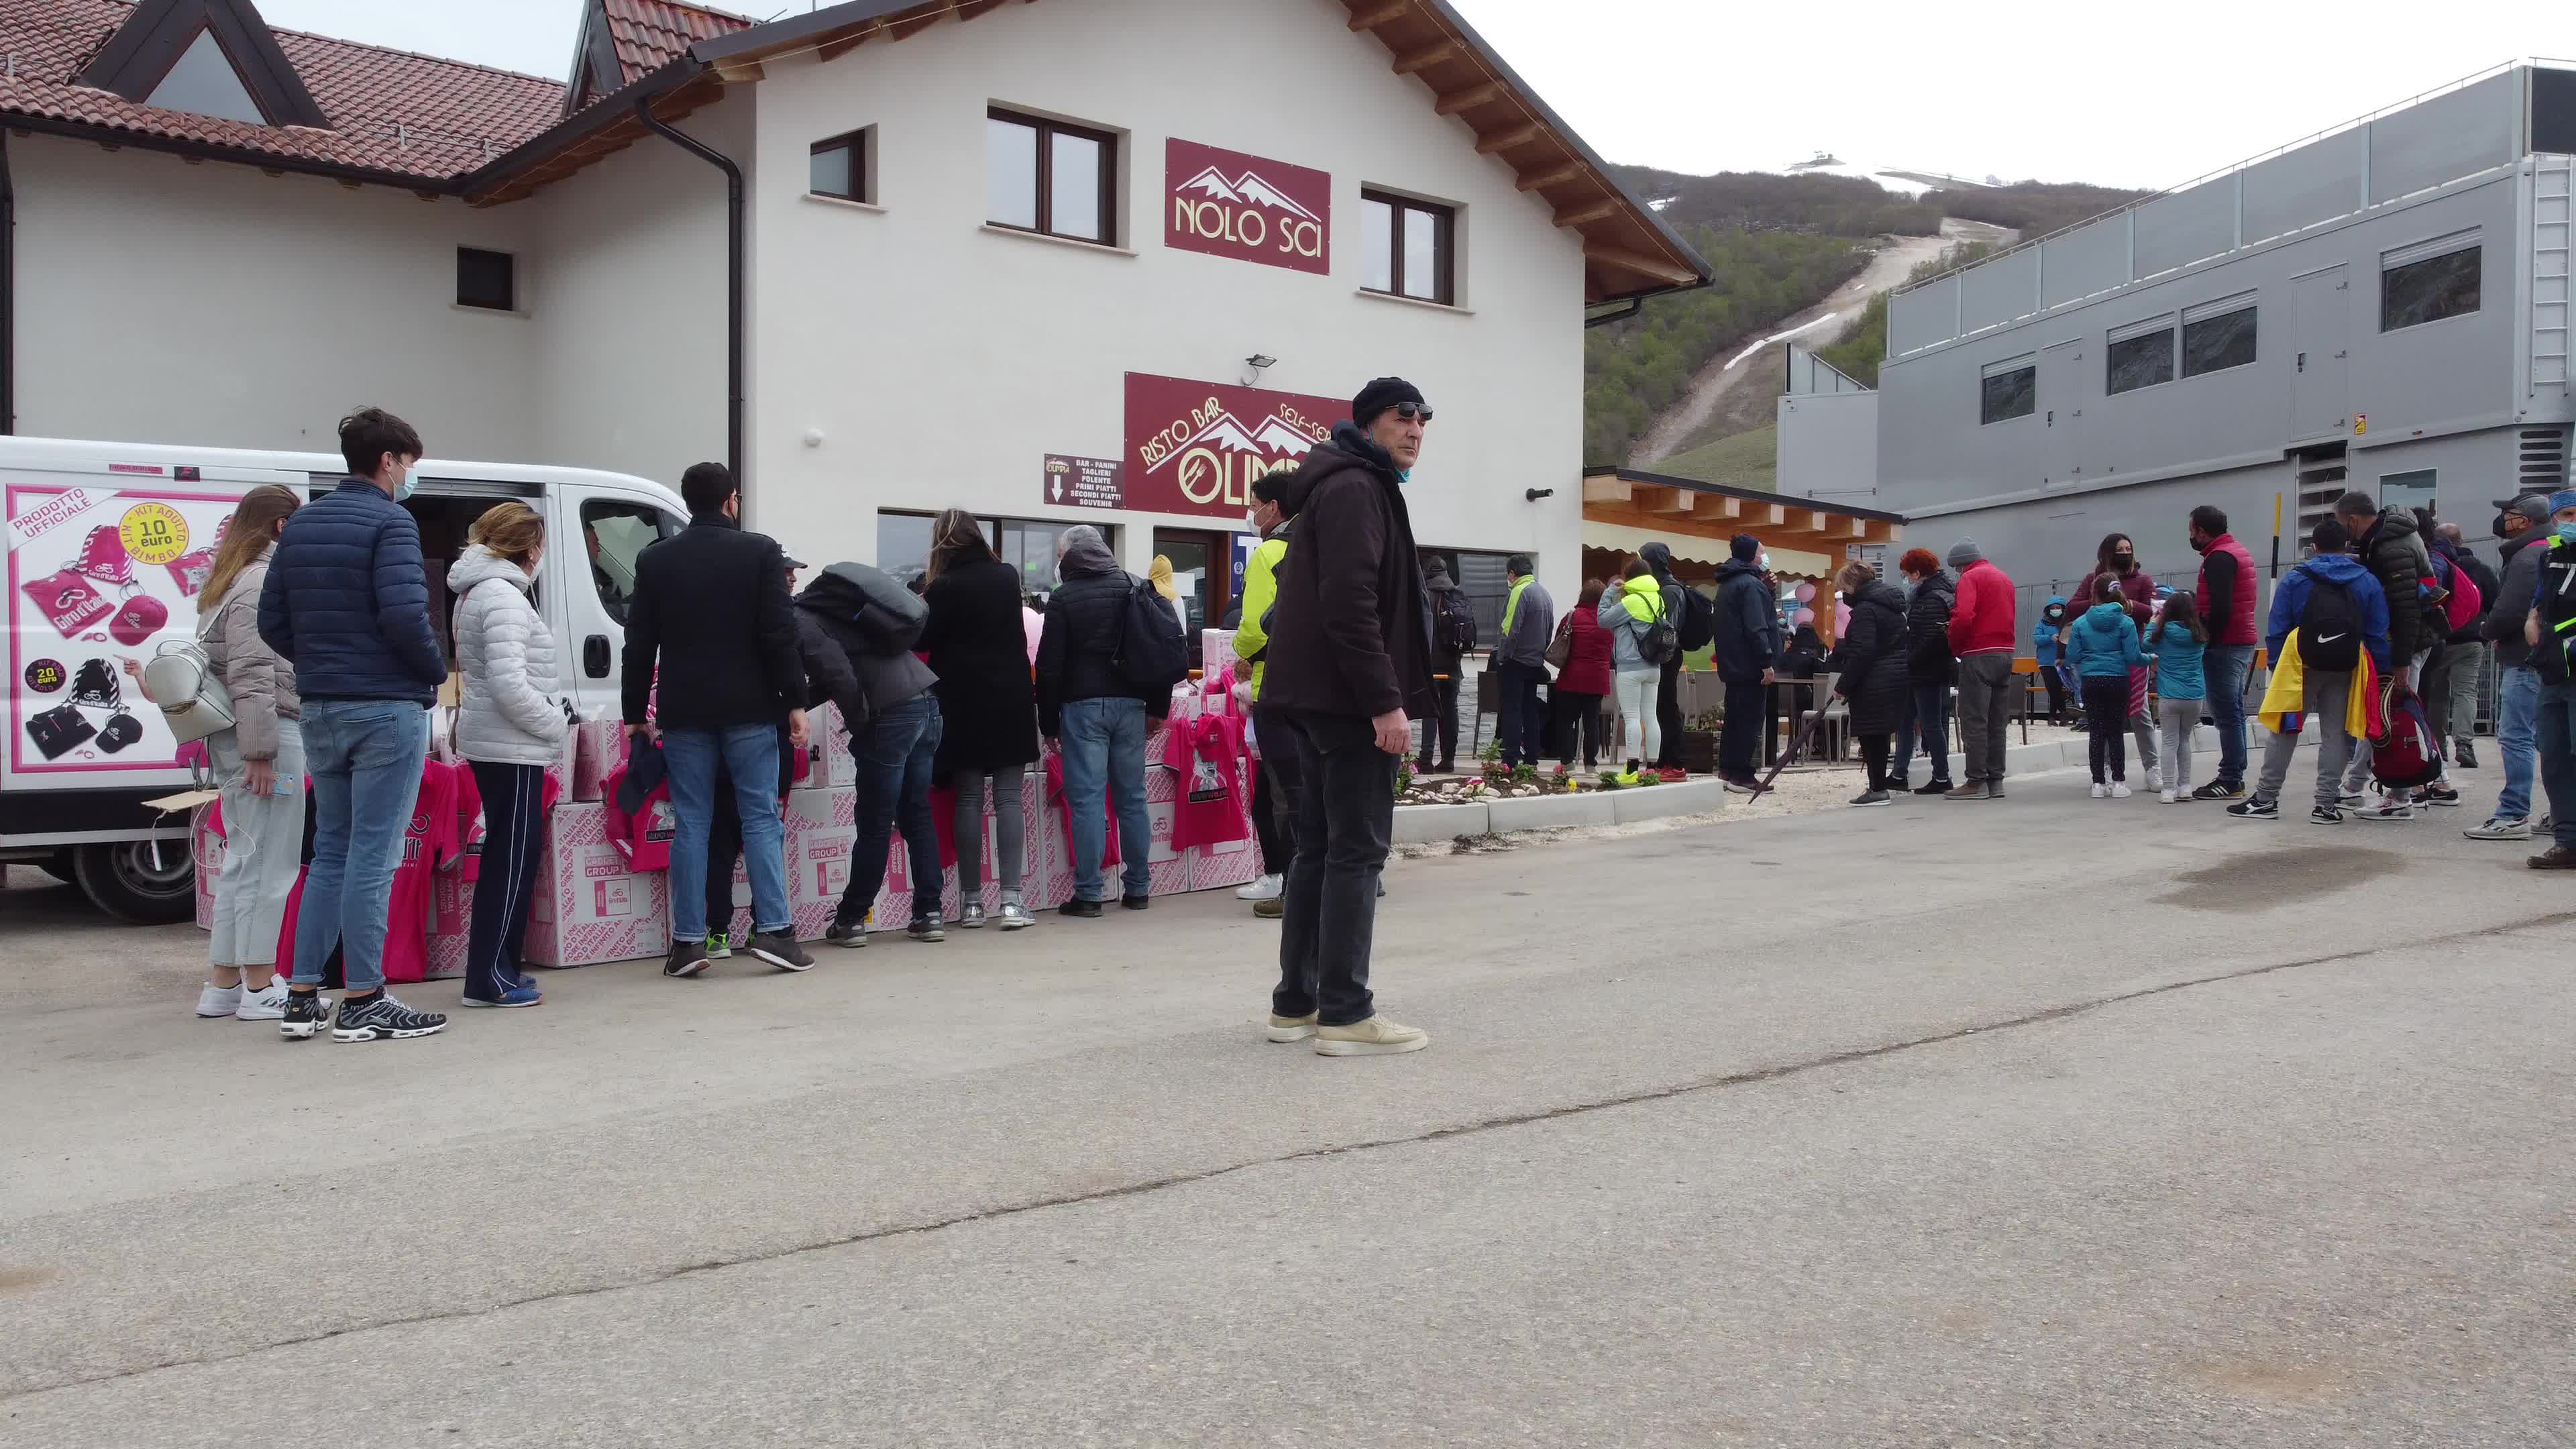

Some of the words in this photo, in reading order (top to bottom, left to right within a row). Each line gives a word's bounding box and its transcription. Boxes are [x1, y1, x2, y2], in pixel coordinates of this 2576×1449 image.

[1176, 197, 1266, 246] NOLO
[1279, 217, 1322, 258] SCI
[1140, 420, 1189, 466] RISTO
[1191, 396, 1224, 429] BAR
[1076, 460, 1089, 468] BAR
[1095, 462, 1117, 470] PANINI
[1082, 468, 1111, 476] TAGLIERI
[1082, 476, 1111, 484] POLENTE
[1095, 484, 1116, 492] PIATTI
[1070, 490, 1099, 498] SECONDI
[1079, 498, 1113, 508] SOUVENIR
[13, 488, 85, 530] PRODOTTO
[24, 498, 91, 537] UFFICIALE
[135, 504, 153, 516] KIT
[157, 506, 186, 541] ADULTO
[140, 520, 166, 537] 10
[141, 536, 172, 547] euro
[131, 547, 176, 562] BIMBO
[38, 667, 54, 678] 20
[810, 849, 837, 859] GROUP
[587, 866, 619, 876] GROUP
